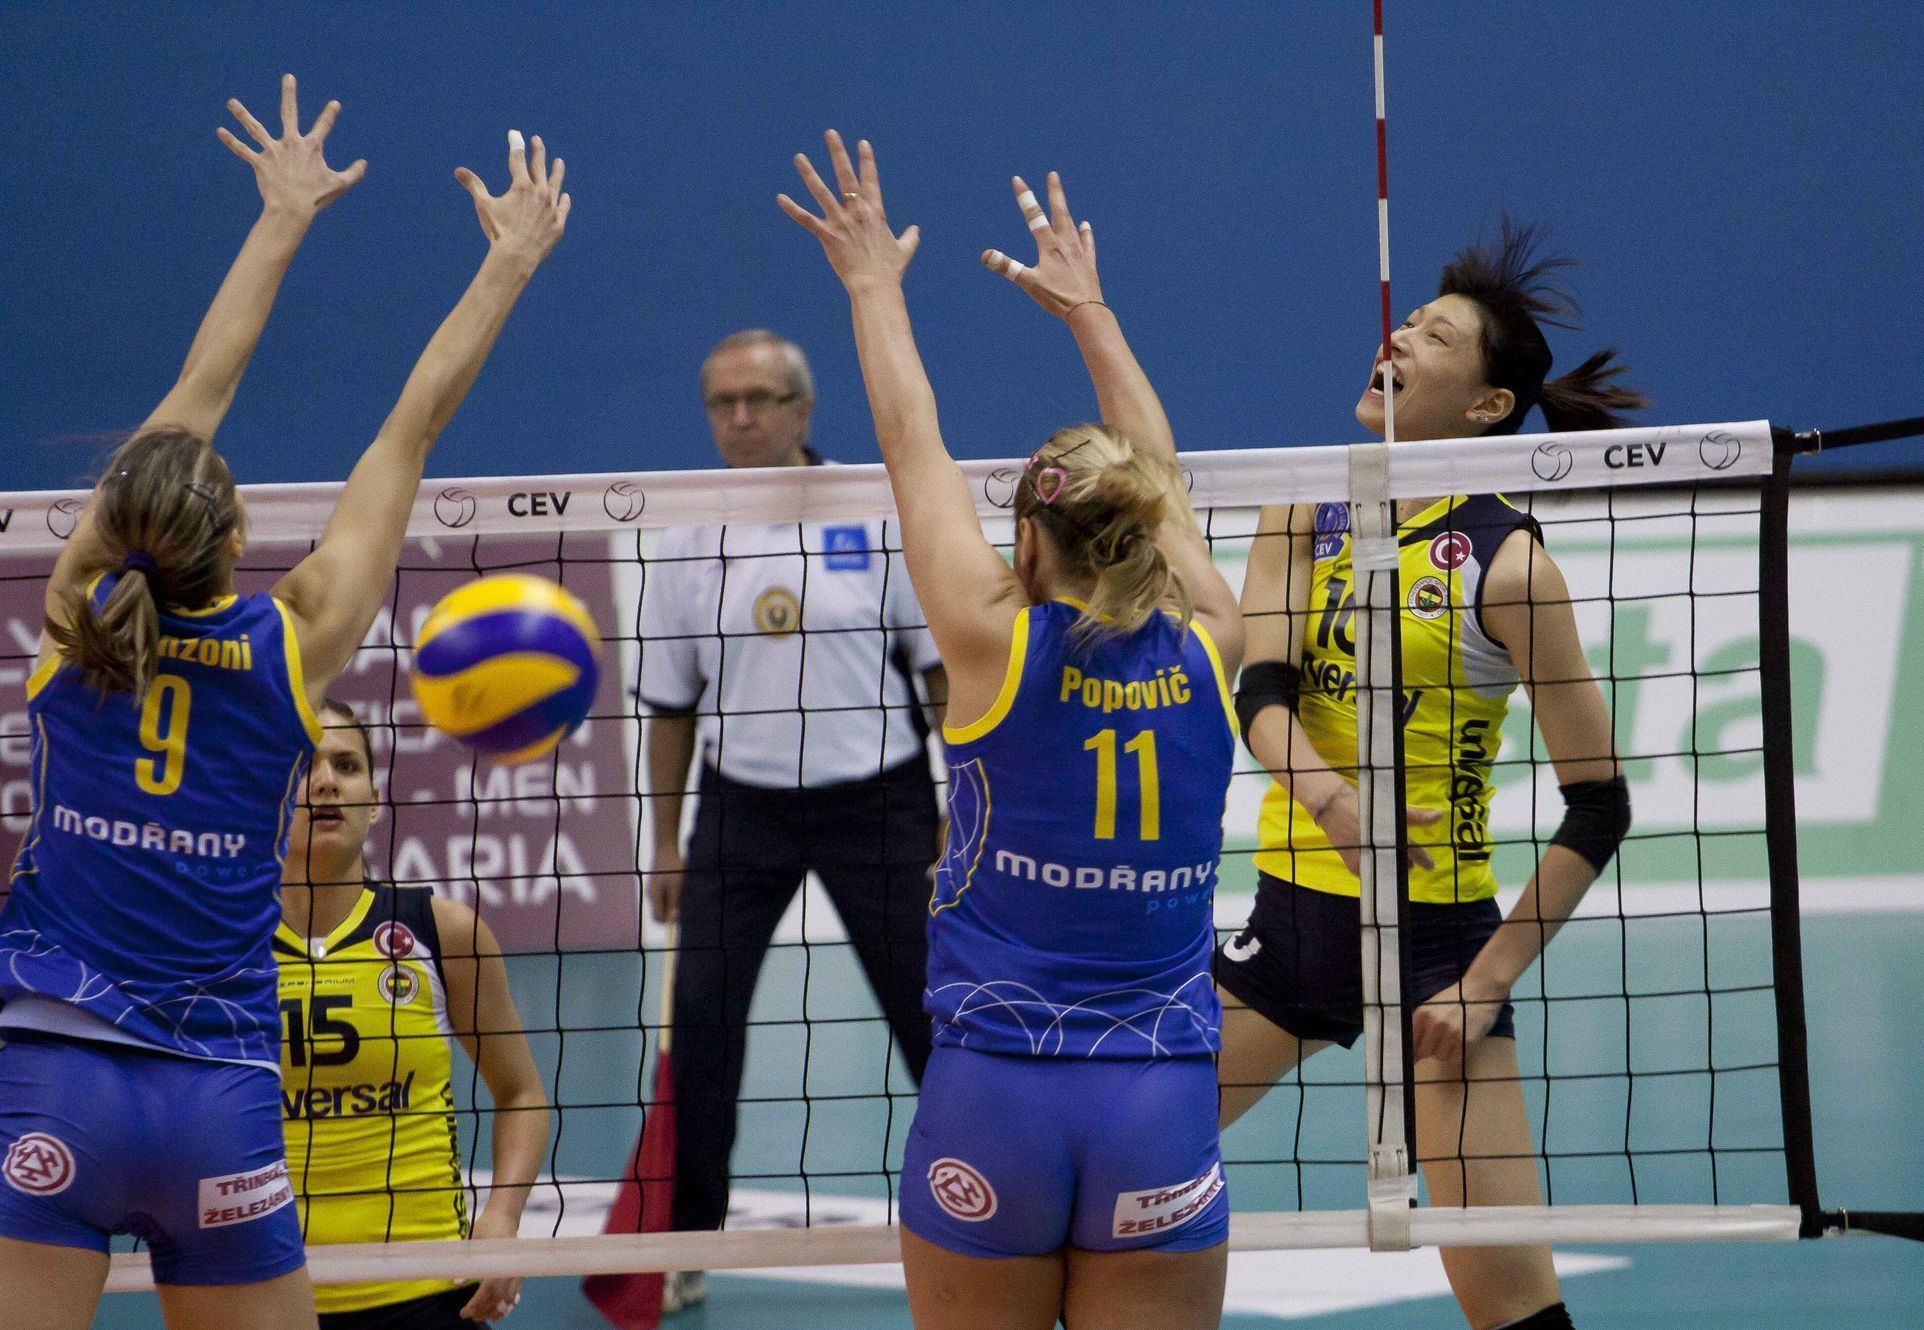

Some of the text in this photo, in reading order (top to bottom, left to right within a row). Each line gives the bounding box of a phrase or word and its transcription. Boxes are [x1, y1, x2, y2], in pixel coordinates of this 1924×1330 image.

[1603, 441, 1667, 469] CEV
[507, 491, 572, 517] CEV
[156, 633, 252, 671] nzoni
[1060, 664, 1191, 713] Popovič
[135, 674, 191, 796] 9
[455, 763, 597, 818] MEN
[1083, 728, 1160, 841] 11
[362, 831, 600, 905] ARIA
[279, 994, 360, 1067] 15
[282, 1070, 415, 1119] versal
